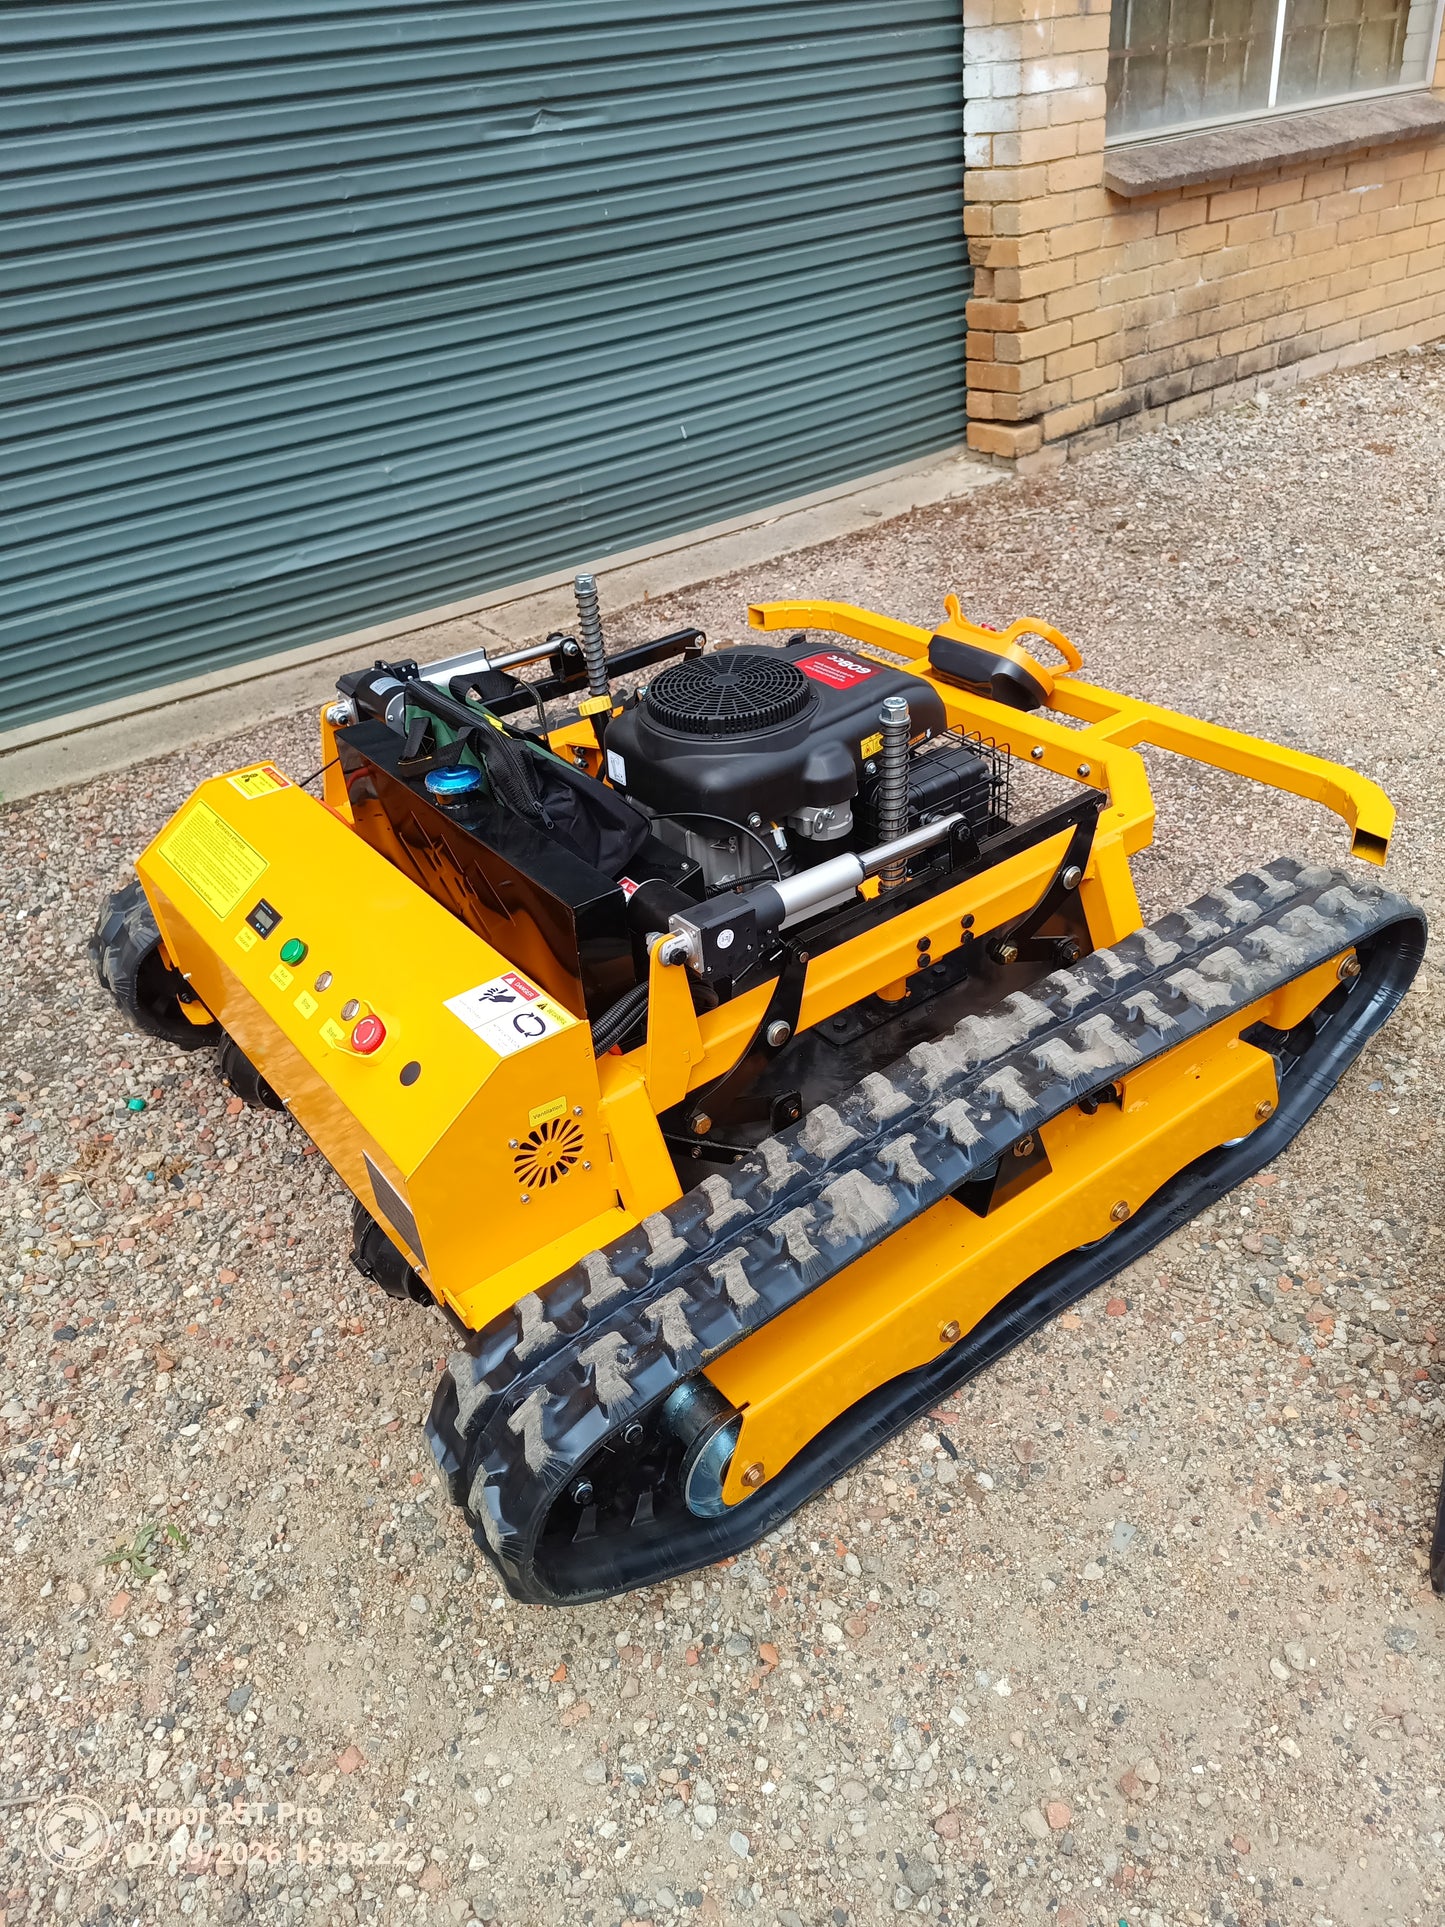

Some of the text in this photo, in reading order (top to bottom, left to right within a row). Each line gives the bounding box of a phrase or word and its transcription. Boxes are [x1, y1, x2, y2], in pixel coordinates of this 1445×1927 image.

[827, 654, 872, 674] 608cc
[513, 981, 535, 998] DANGER
[532, 1104, 564, 1119] Ventilation
